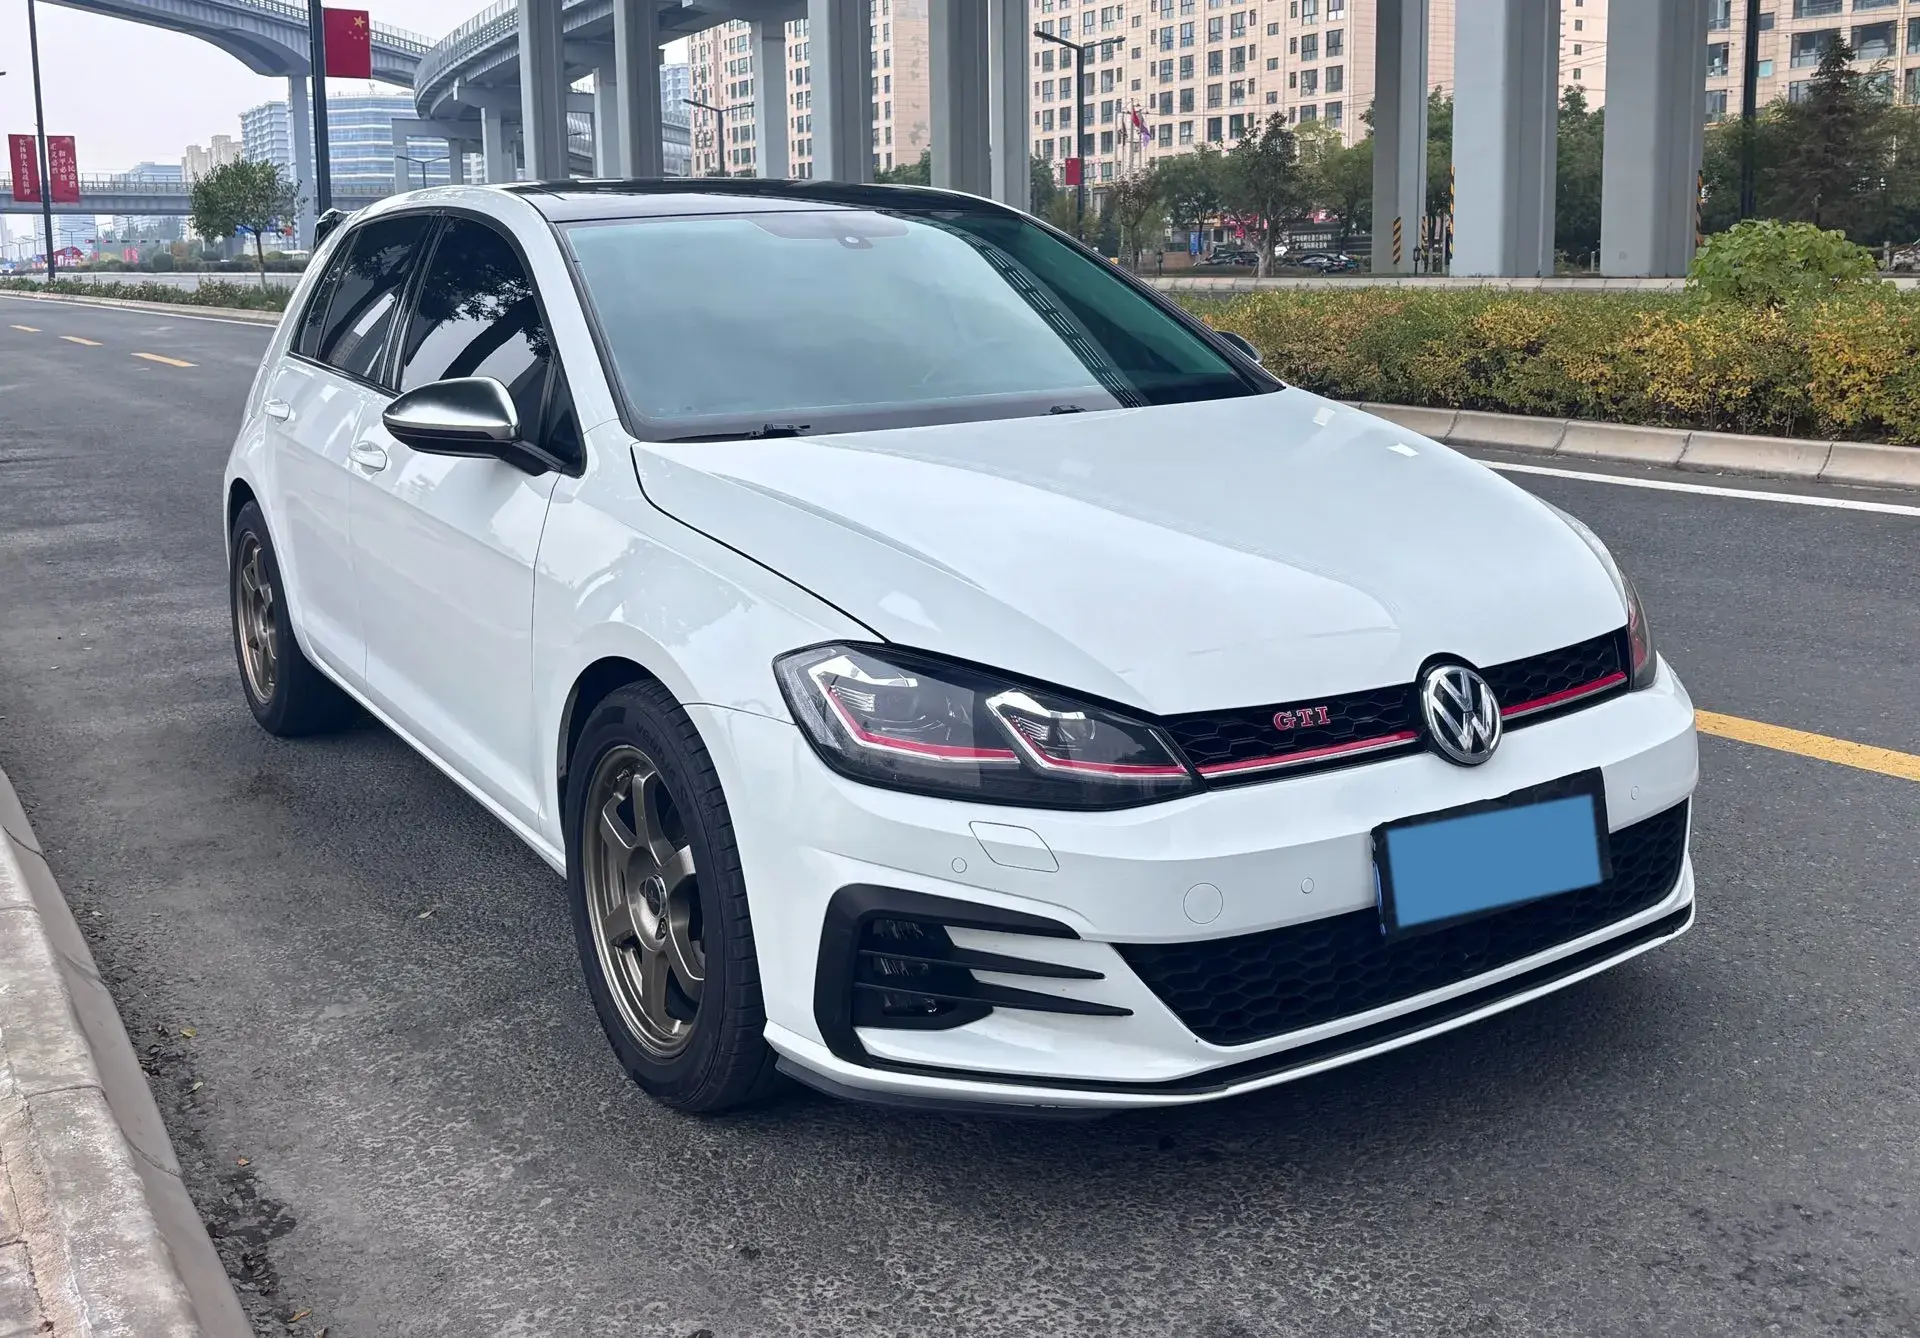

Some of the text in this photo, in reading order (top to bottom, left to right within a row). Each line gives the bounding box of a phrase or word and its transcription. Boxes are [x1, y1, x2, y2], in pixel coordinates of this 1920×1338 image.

[59, 150, 67, 181] 和平必胜
[68, 156, 76, 188] 人民必胜
[1273, 706, 1331, 730] GTI
